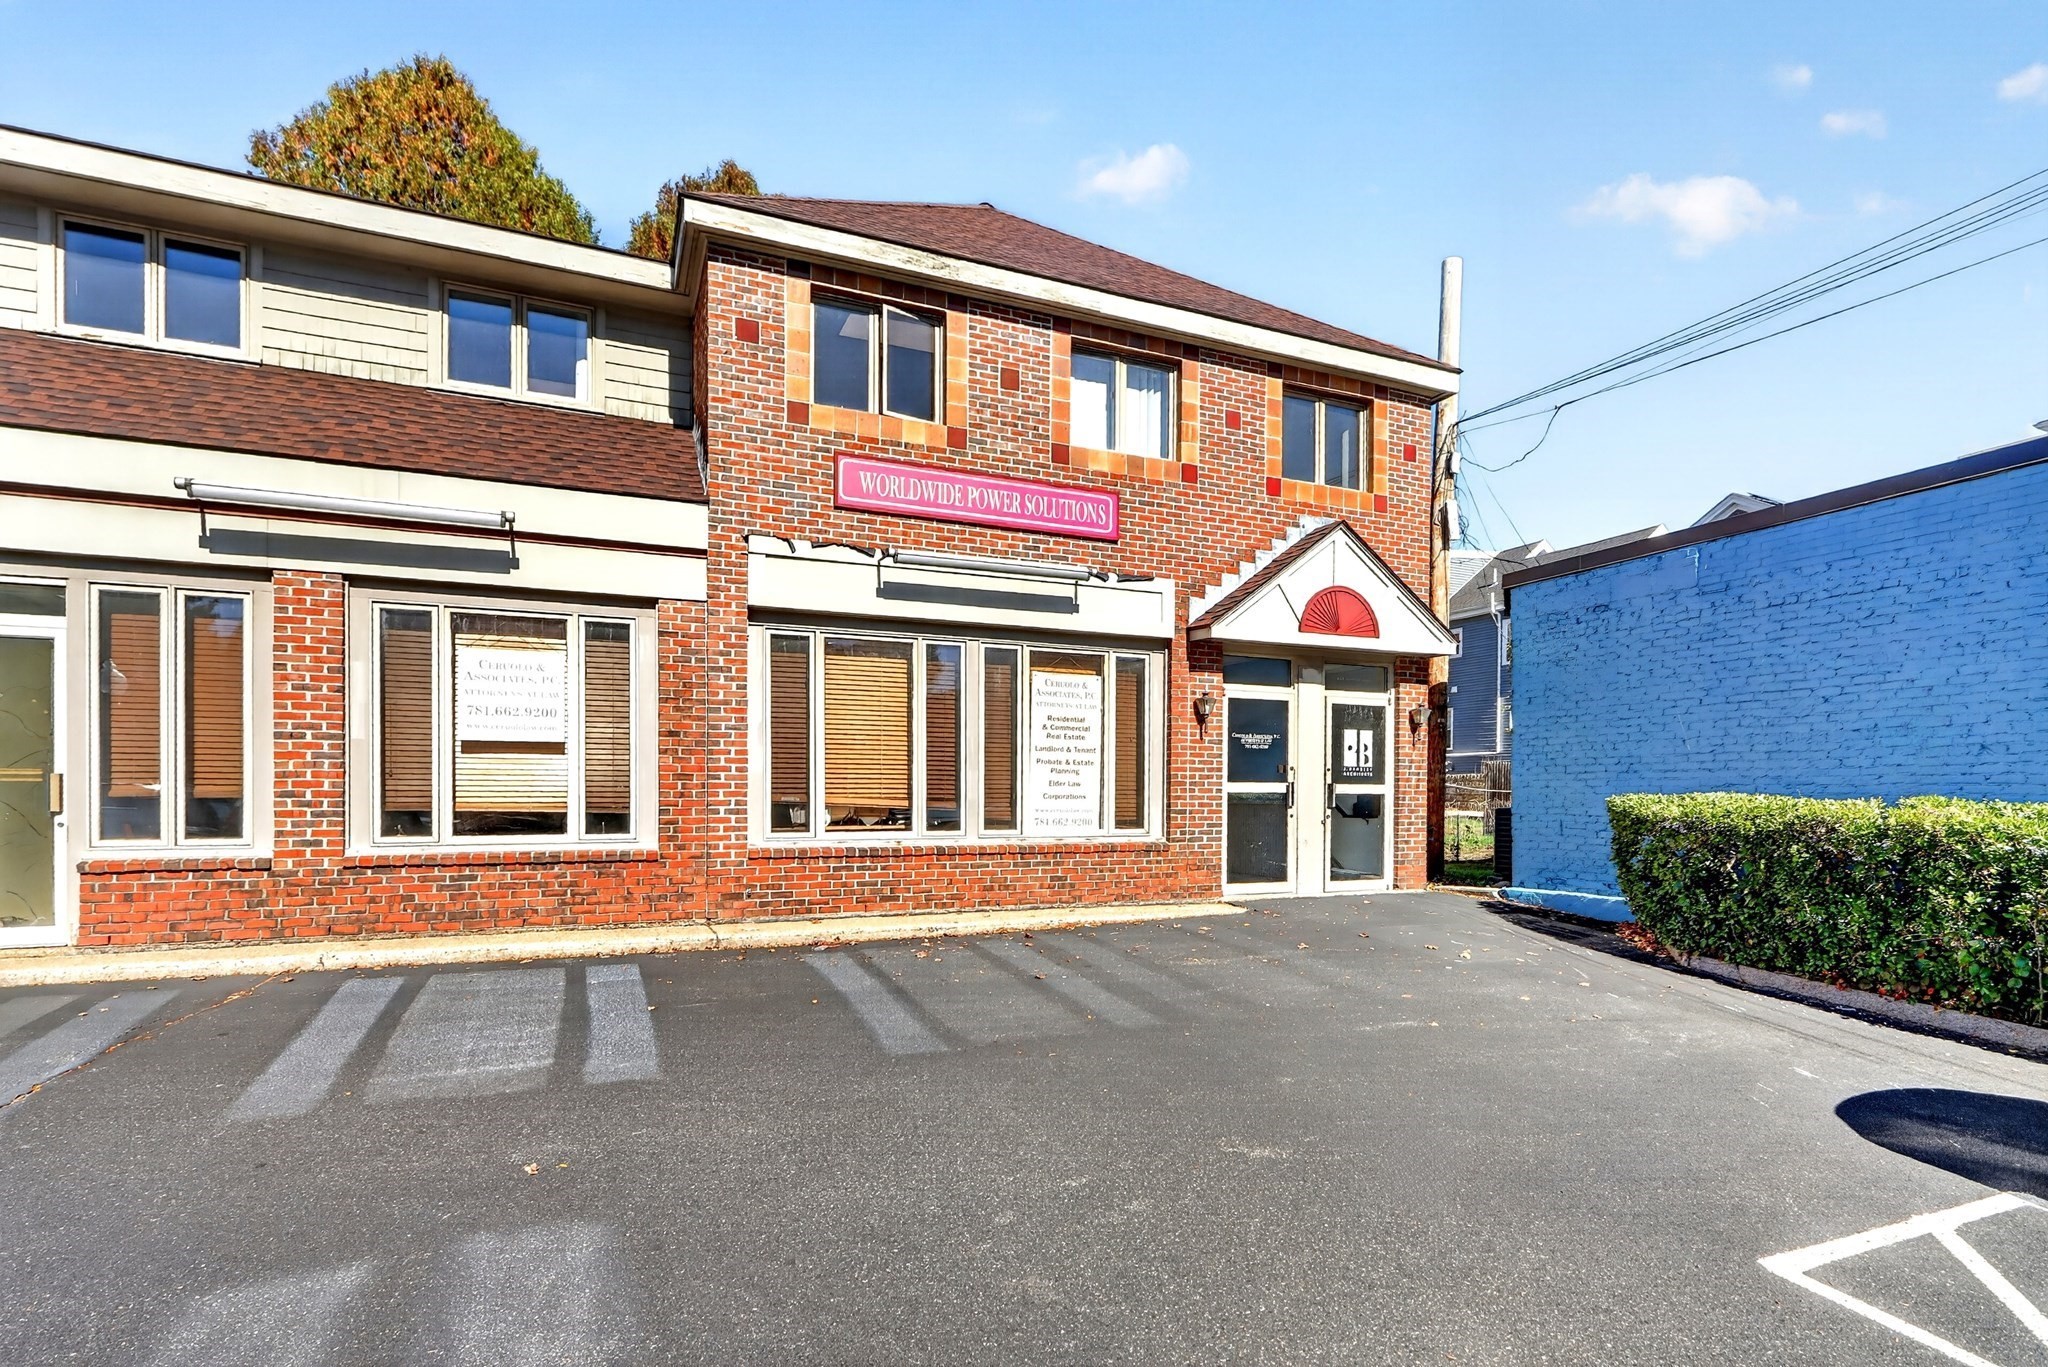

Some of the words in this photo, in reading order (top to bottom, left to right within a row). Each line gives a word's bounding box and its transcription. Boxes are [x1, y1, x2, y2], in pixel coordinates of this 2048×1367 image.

[858, 470, 963, 506] WORLDWIDE
[967, 486, 1021, 514] POWER
[1024, 494, 1106, 525] SOLUTIONS
[536, 663, 545, 672] &
[467, 704, 558, 718] 781.662.9200
[1047, 714, 1086, 723] Residential
[1042, 723, 1048, 731] &
[1050, 723, 1091, 732] Commercial
[1046, 732, 1062, 740] Real
[1063, 733, 1086, 741] Estate
[1034, 745, 1065, 753] Landlord
[1074, 746, 1097, 754] Tenant
[1036, 758, 1063, 766] Probate
[1065, 758, 1071, 766] &
[1072, 759, 1095, 767] Estate
[1050, 767, 1080, 776] Planning
[1048, 779, 1066, 787] Elder
[1043, 792, 1087, 800] Corporations
